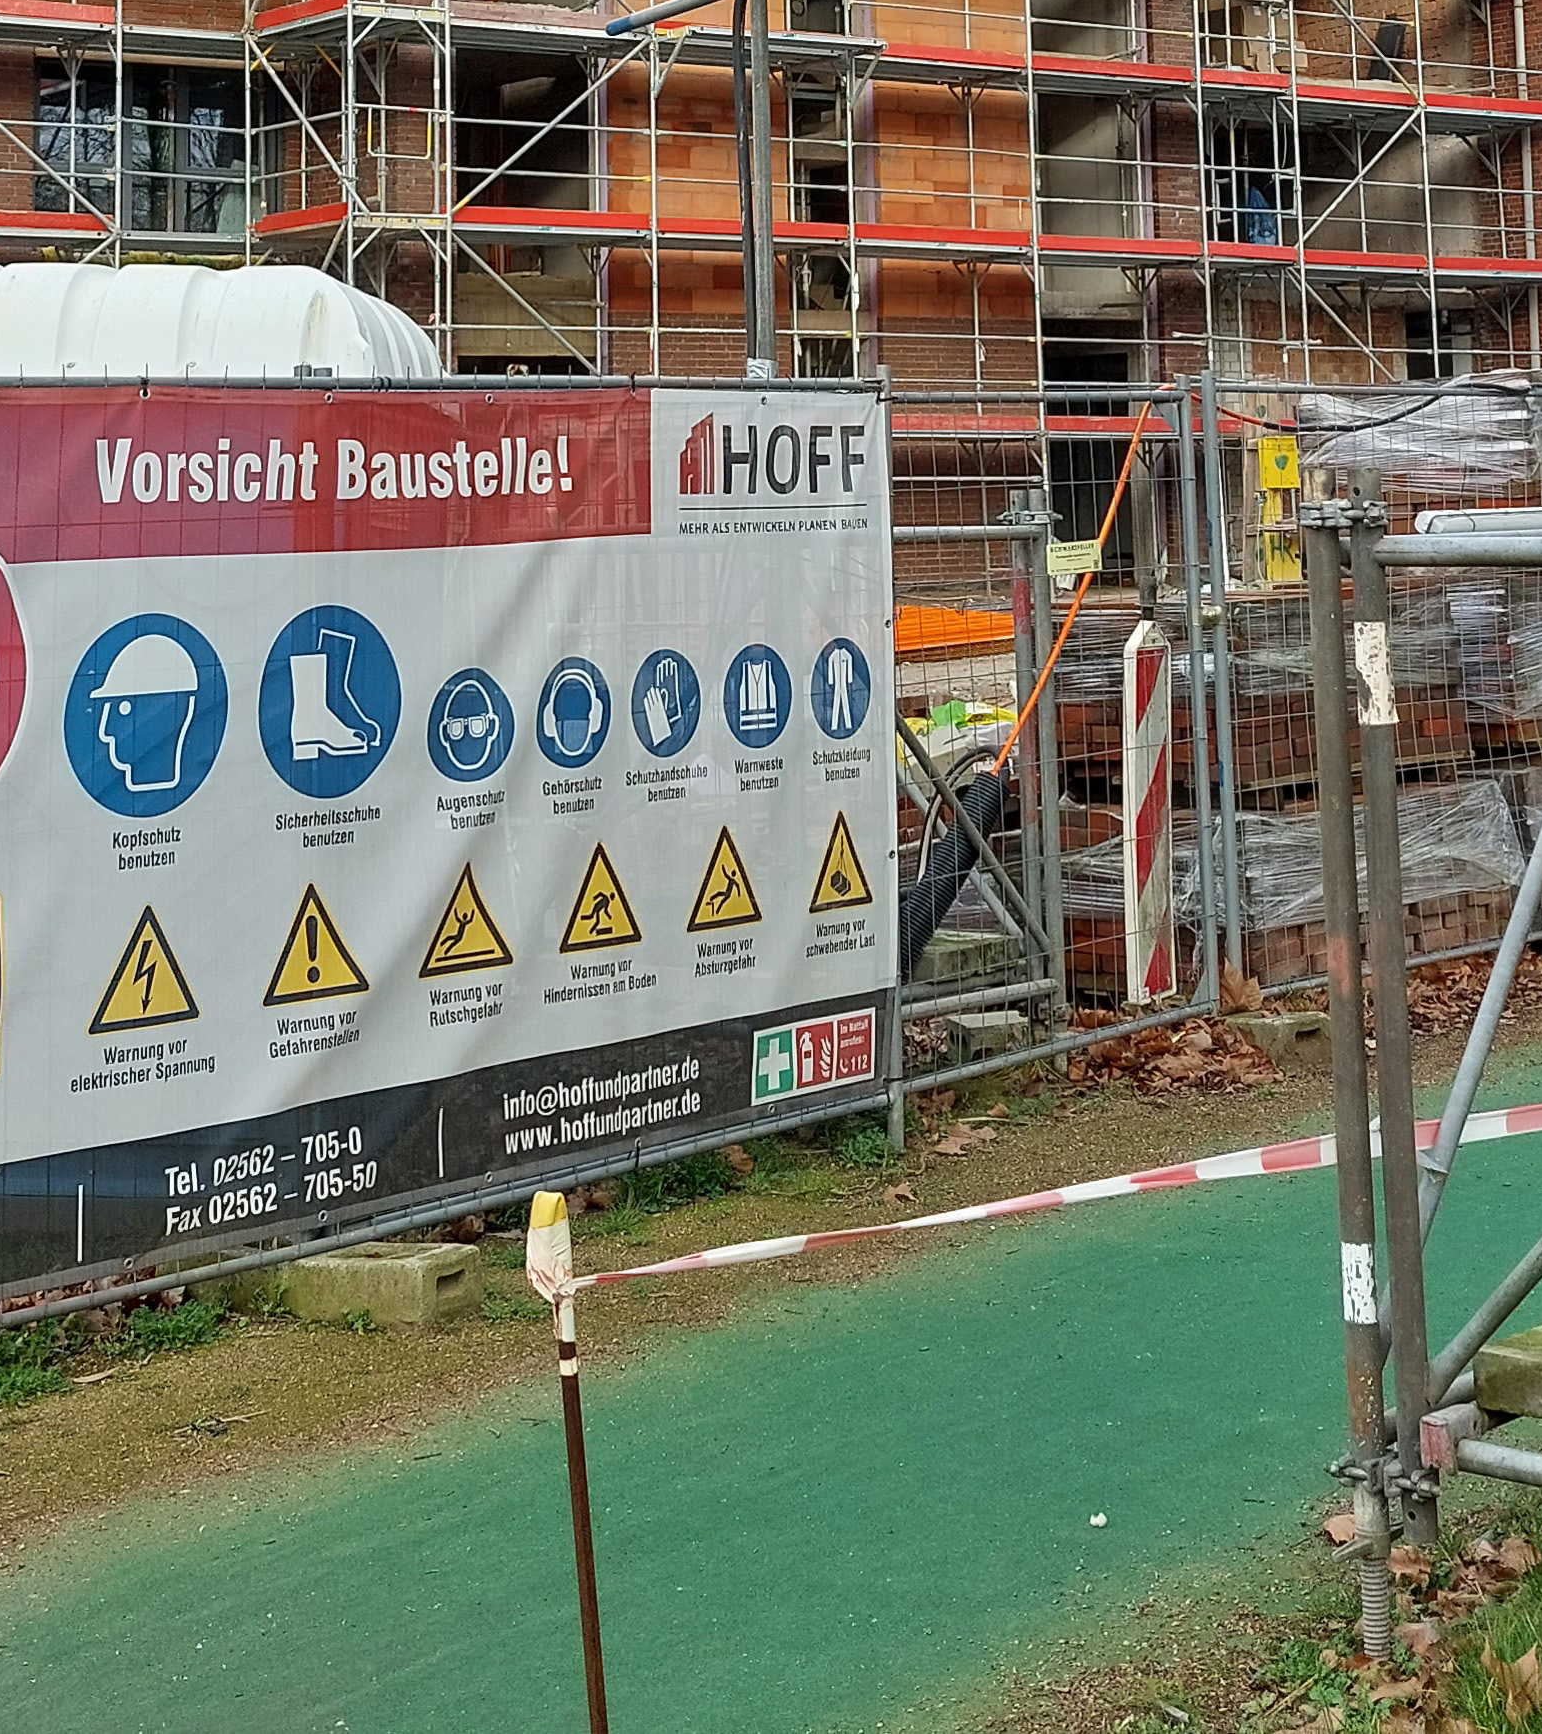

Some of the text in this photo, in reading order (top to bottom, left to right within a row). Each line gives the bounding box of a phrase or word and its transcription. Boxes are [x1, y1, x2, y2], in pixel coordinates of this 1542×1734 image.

[96, 435, 573, 503] Vorsicht Baustelle!
[722, 424, 865, 495] HOFF
[679, 518, 868, 535] MEHR ALS ENTWICKELN PLANEN BAUEN
[734, 756, 784, 774] Warnweste
[812, 747, 871, 766] Schutzkleidung
[542, 776, 603, 796] Gehörschutz
[625, 763, 708, 787] Schutzhandschuhe
[740, 775, 779, 792] benutzen
[825, 767, 860, 782] benutzen
[436, 789, 505, 812] Augenschutz
[553, 798, 595, 815] benutzen
[647, 786, 686, 803] benutzen
[275, 804, 381, 831] Sicherheitsschuhe
[450, 811, 496, 830] benutzen
[112, 826, 181, 850] Kopfschutz
[302, 829, 354, 848] benutzen
[118, 850, 176, 871] benutzen
[816, 918, 866, 937] Warnung vor
[696, 937, 754, 958] Warnung vor
[805, 933, 876, 958] schwebender Last
[570, 959, 633, 980] Warnung vor
[694, 954, 756, 978] Absturzgefahr
[429, 982, 503, 1006] Warnung vor
[543, 973, 657, 1005] Hindernissen am Boden
[277, 1010, 357, 1036] Warnung vor
[429, 1001, 503, 1027] Rutschgefahr
[103, 1038, 188, 1066] Warnung vor
[269, 1028, 360, 1059] Gefahrenstellen
[70, 1055, 216, 1093] elektrischer Spannung
[850, 1054, 868, 1071] 112
[503, 1054, 700, 1120] info@hoffundpartner.de
[164, 1162, 206, 1197] Tel.
[213, 1144, 275, 1187] 02562
[301, 1126, 363, 1165] 705-0
[165, 1204, 203, 1236] Fax
[208, 1182, 278, 1224] 02562
[303, 1160, 378, 1203] 705-50
